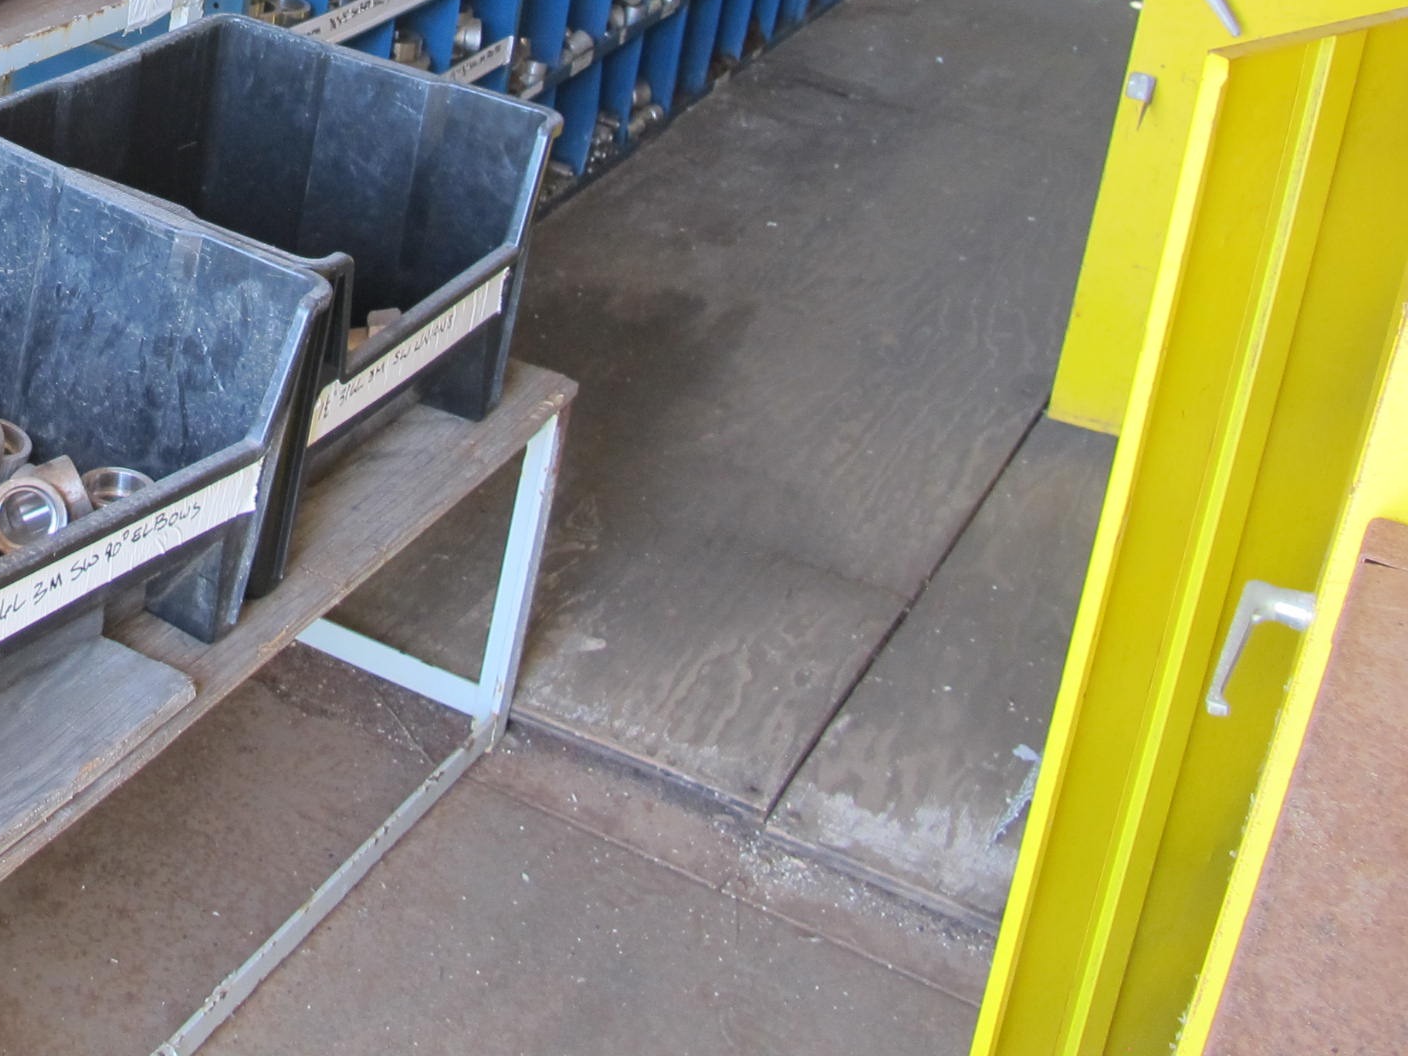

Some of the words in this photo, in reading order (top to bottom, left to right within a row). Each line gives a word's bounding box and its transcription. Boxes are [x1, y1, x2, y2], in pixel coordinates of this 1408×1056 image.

[32, 572, 63, 606] 3M
[70, 552, 100, 583] SW
[131, 502, 202, 542] ELBOWS
